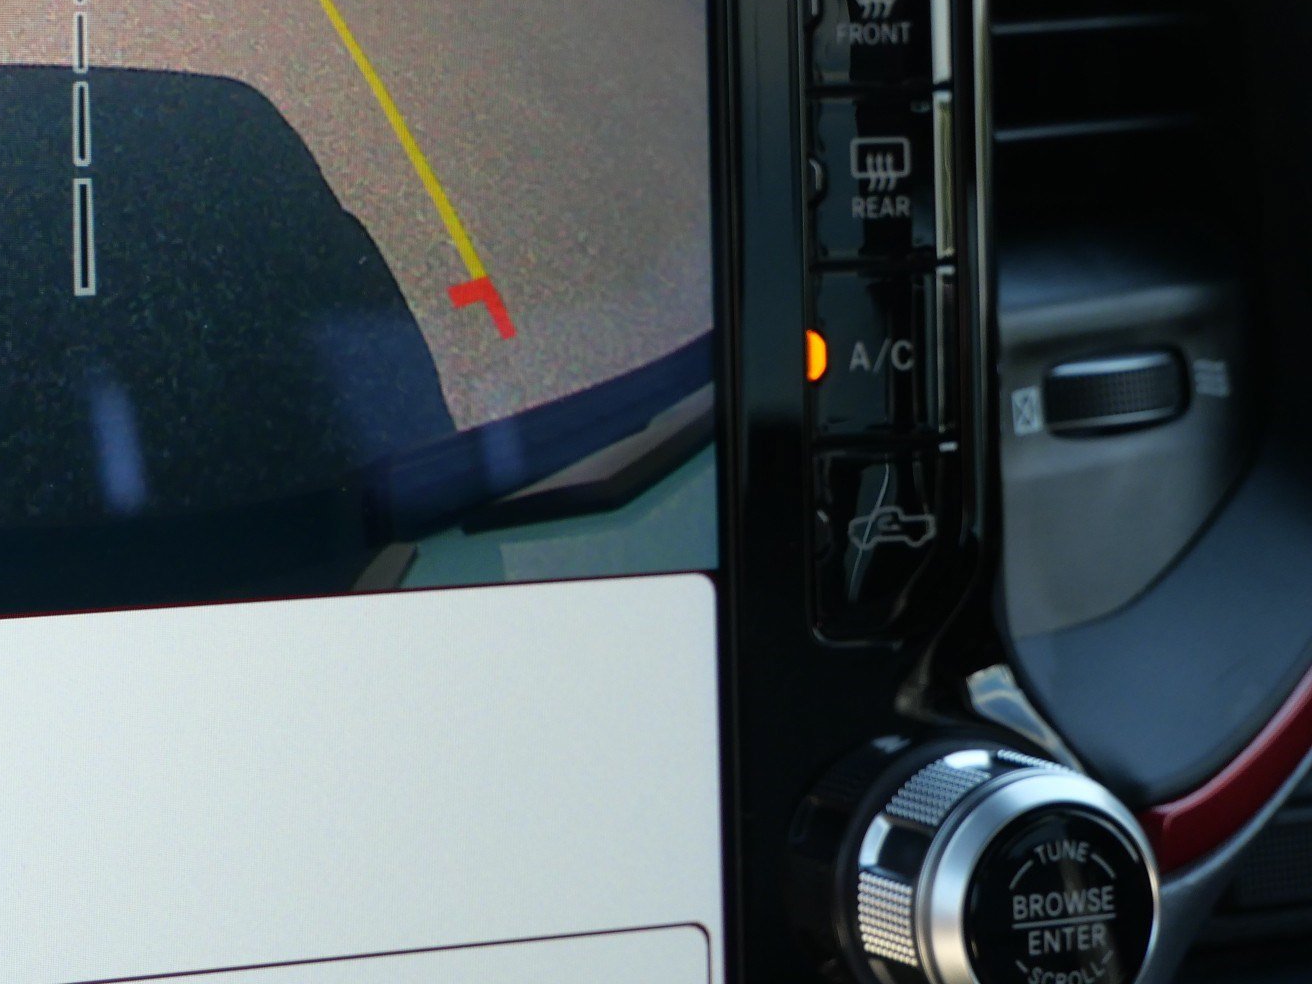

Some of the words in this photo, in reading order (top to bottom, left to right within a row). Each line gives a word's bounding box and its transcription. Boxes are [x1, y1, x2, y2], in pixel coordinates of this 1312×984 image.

[835, 20, 912, 46] FRONT
[851, 195, 912, 219] REAR
[849, 337, 916, 375] A/C
[1032, 839, 1090, 865] TUNE
[1012, 885, 1115, 920] BROWSE
[1027, 922, 1108, 957] ENTER
